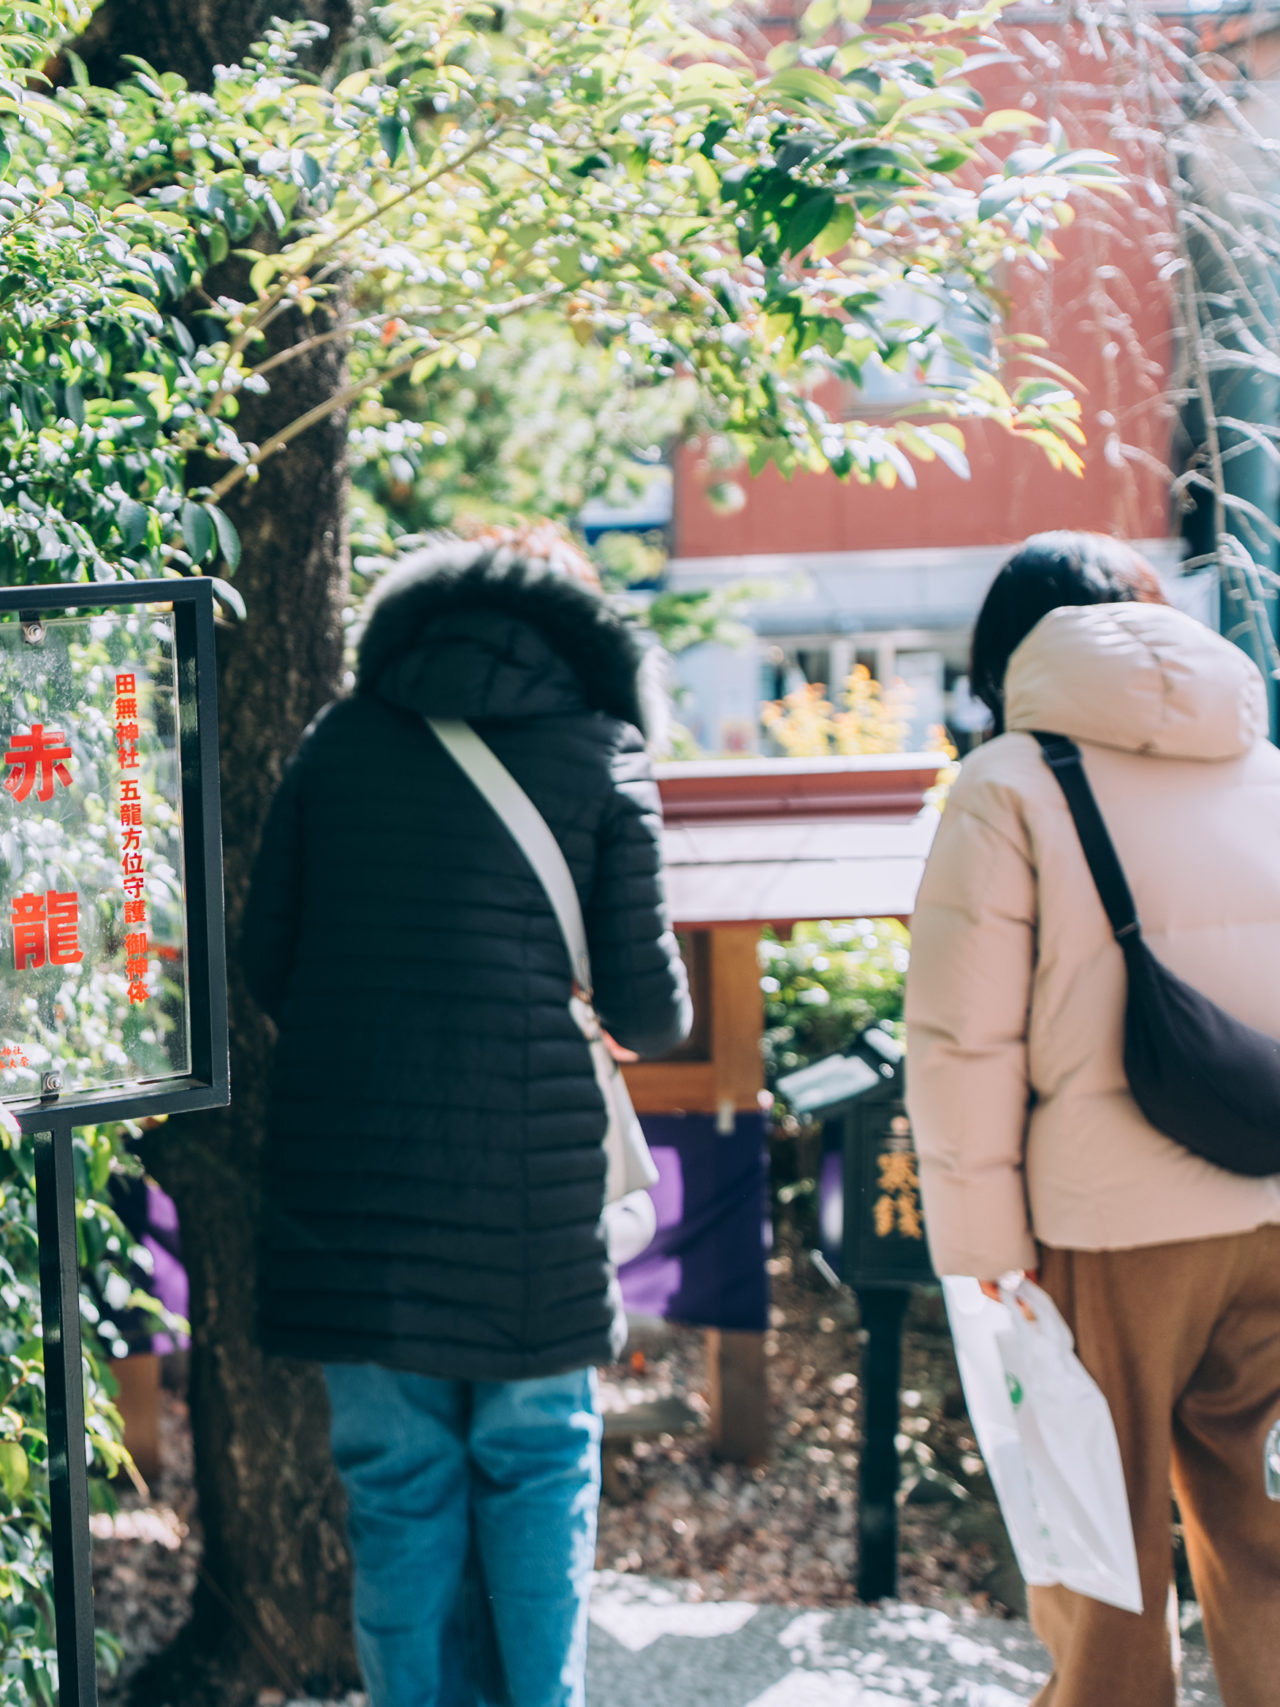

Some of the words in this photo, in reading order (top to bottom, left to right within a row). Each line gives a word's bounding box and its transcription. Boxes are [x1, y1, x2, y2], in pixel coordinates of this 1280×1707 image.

[115, 673, 140, 769] 田無神社
[3, 723, 84, 971] 赤龍
[119, 778, 147, 924] 五龍方位守護
[123, 932, 150, 1005] 御神体
